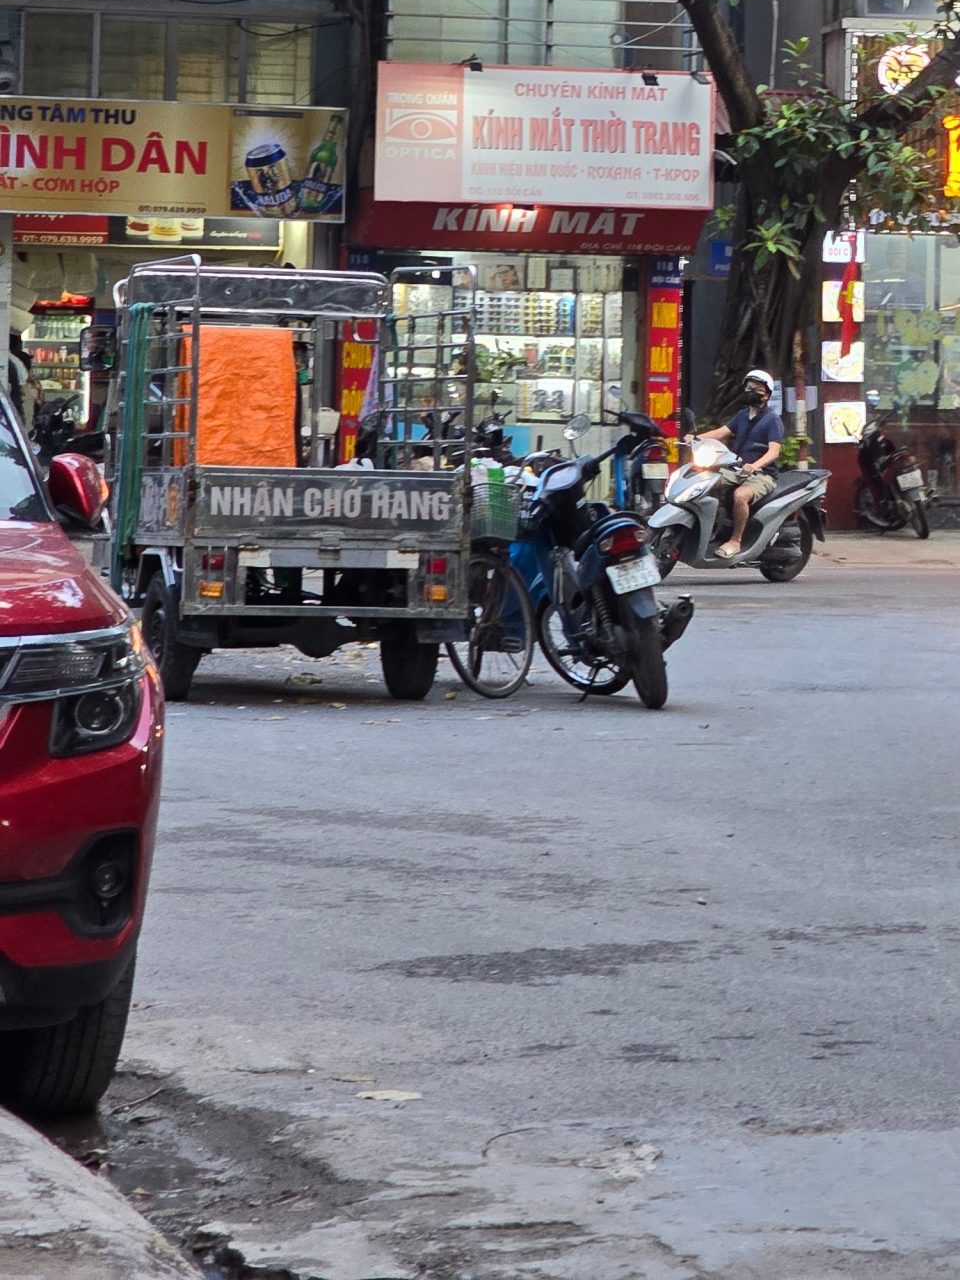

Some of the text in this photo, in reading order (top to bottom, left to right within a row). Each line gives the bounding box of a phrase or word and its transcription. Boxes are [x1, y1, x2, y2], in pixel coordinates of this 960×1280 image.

[514, 81, 582, 99] CHUYÊN
[587, 82, 626, 100] KÍNH
[37, 103, 86, 123] TÂM
[90, 108, 137, 125] THU
[472, 107, 700, 156] KÍNH MẮT THỜI TRANG
[101, 131, 208, 175] DÂN
[384, 146, 456, 159] OPTICA
[587, 166, 641, 180] ROXANA
[32, 177, 75, 192] CƠM
[80, 177, 119, 197] HỘP
[432, 204, 538, 232] KÍNH
[210, 481, 294, 522] NHẬN
